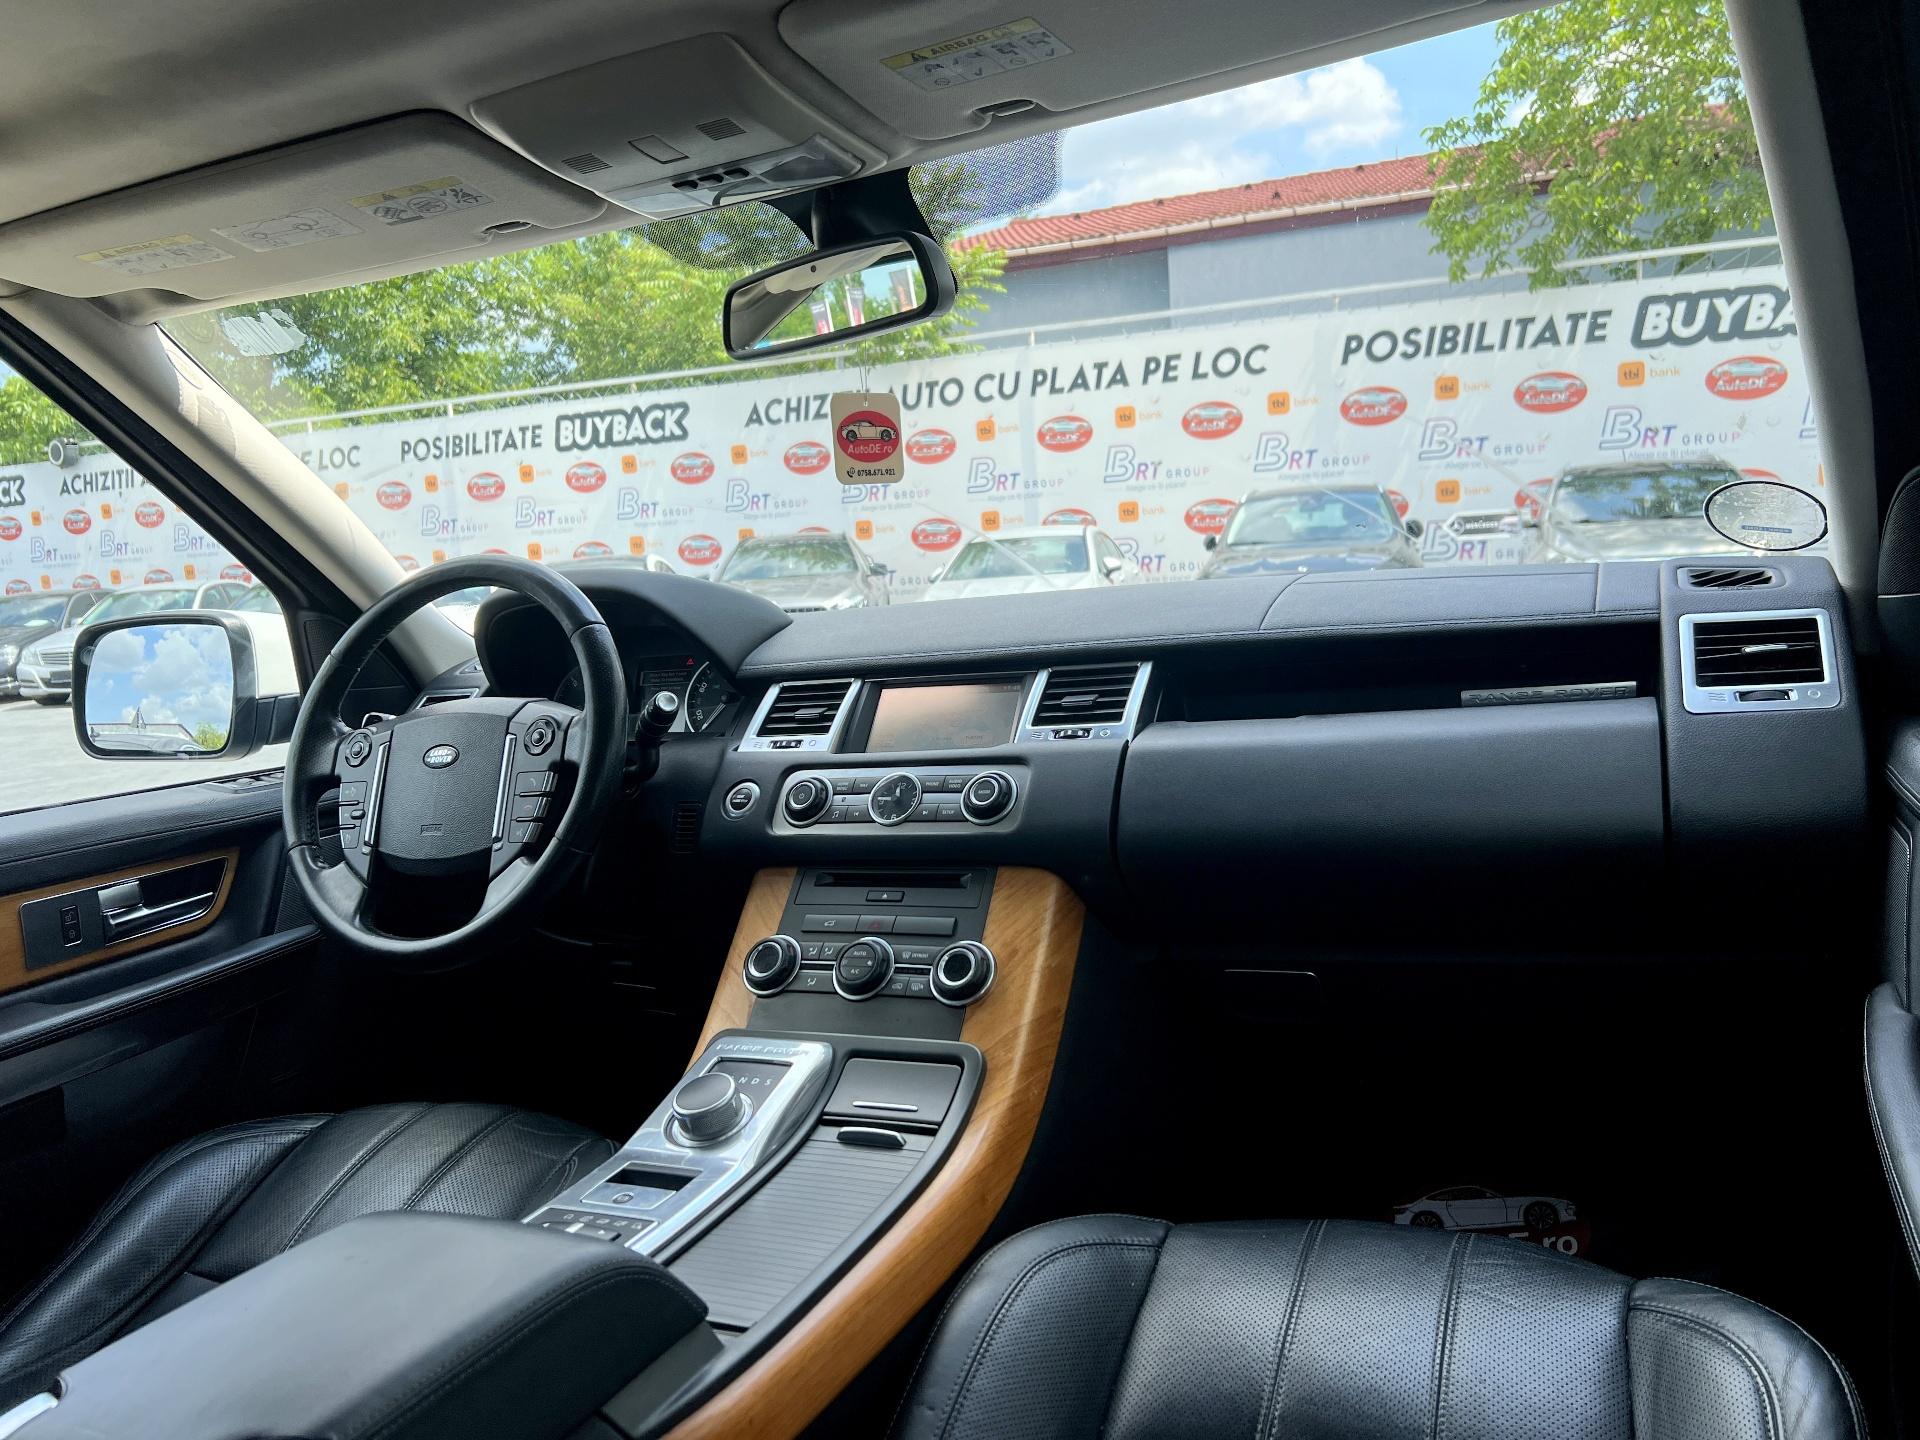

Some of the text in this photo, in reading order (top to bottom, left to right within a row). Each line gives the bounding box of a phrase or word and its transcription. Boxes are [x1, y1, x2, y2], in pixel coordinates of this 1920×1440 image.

[1341, 288, 1798, 366] POSIBILITATE BUYBA
[744, 344, 1270, 428] ACHIZ UTO CU PLATA PE LOC
[400, 404, 687, 462] POSIBILITATE BUYBACK
[1418, 416, 1489, 461] BRT
[1599, 405, 1741, 450] BRT GROUP
[318, 445, 361, 470] LOC
[1104, 444, 1162, 483] BRT
[1253, 432, 1370, 472] BRT GROUP
[967, 457, 1020, 493] BRT
[618, 487, 659, 520] BRT
[726, 479, 770, 513] BRT
[1555, 686, 1629, 698] ROVER
[430, 749, 447, 757] LAND
[430, 756, 452, 764] ROVER
[738, 1076, 773, 1086] N D S
